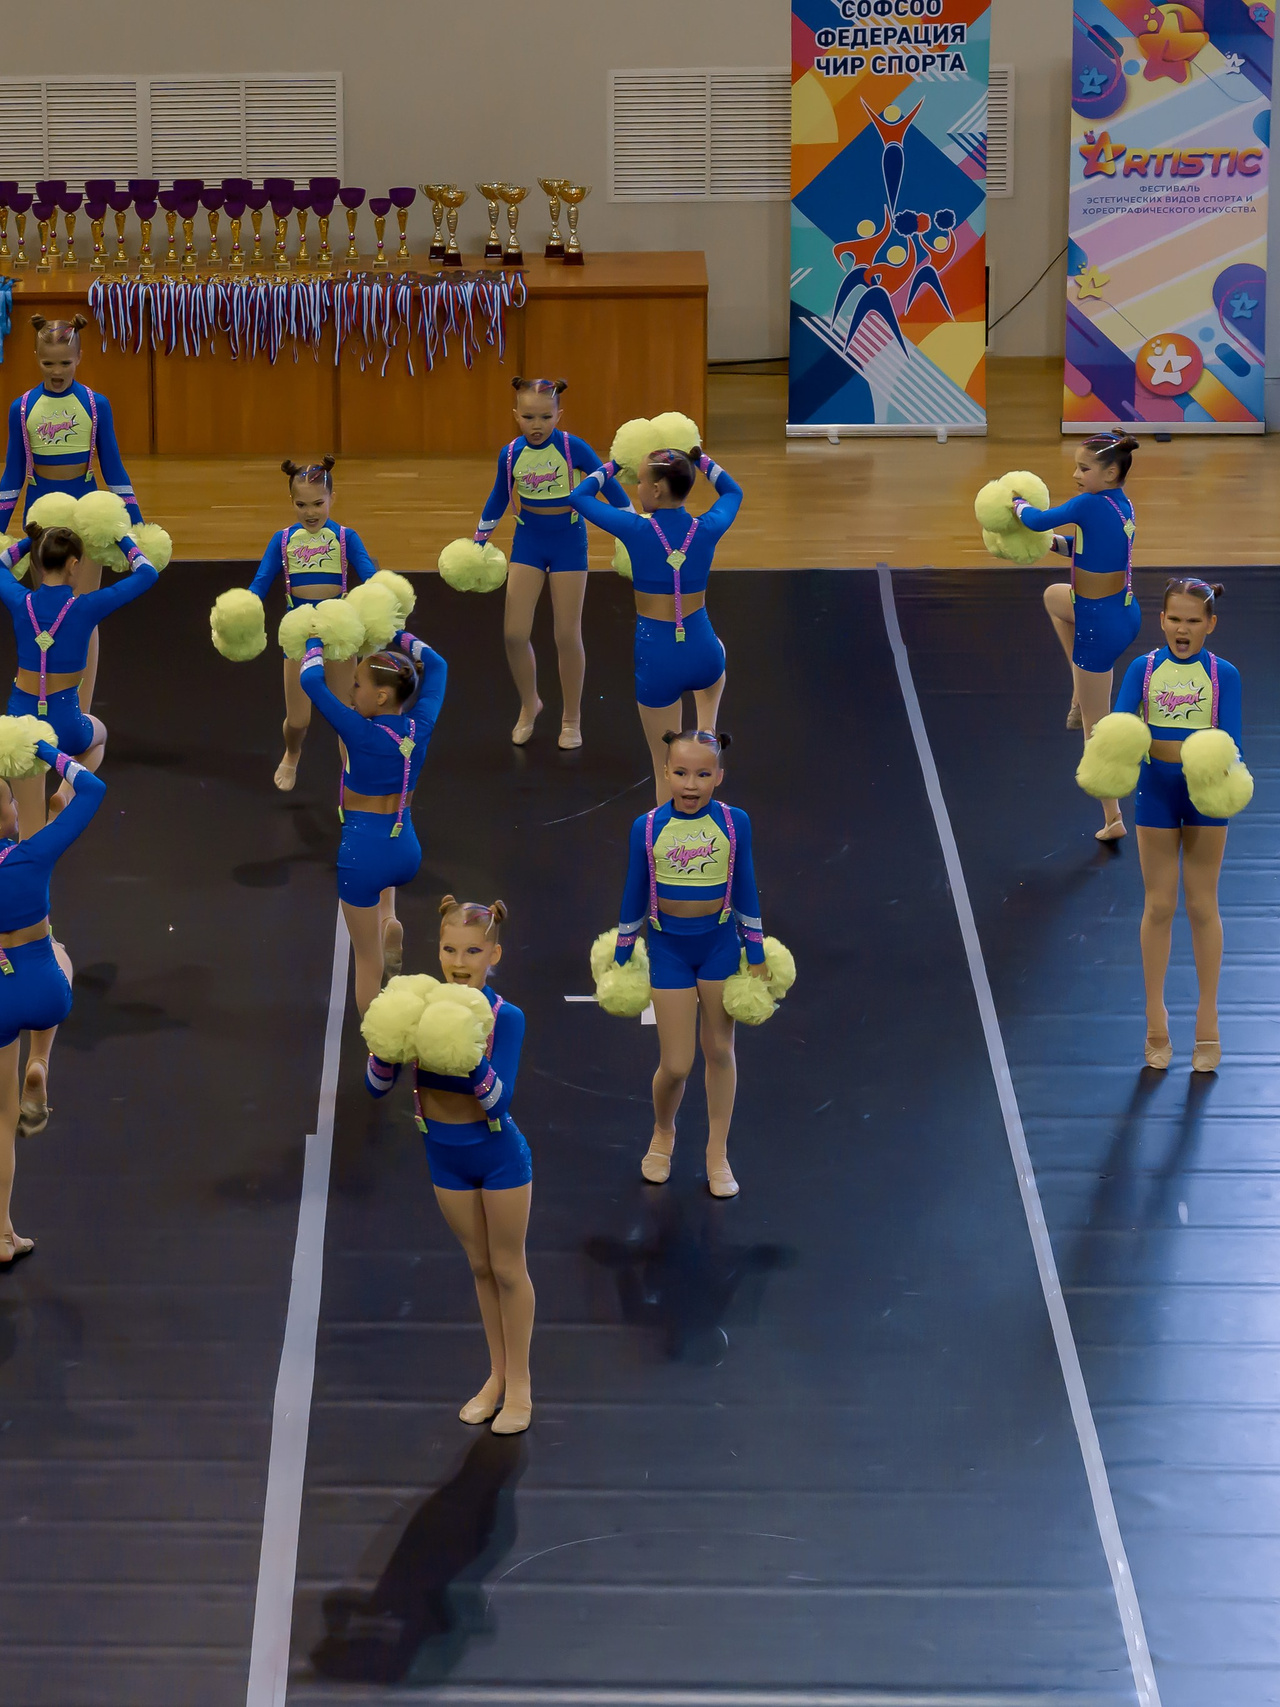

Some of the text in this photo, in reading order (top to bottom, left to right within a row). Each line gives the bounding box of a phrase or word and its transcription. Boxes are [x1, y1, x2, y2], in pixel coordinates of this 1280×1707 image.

[841, 0, 942, 18] СОФСОО
[816, 24, 966, 49] ФЕДЕРАЦИЯ
[815, 53, 966, 76] ЧИР СПОРТА
[1139, 185, 1201, 193] ФЕСТИВАЛЬ
[1086, 196, 1163, 204] ЭСТЕТИЧЕСКИХ
[1165, 195, 1201, 204] ВИДОВ
[1203, 195, 1243, 203] СПОРТА
[1082, 206, 1257, 215] ХОРЕОГРАФИЧЕСКОГО ИСКУССТВА
